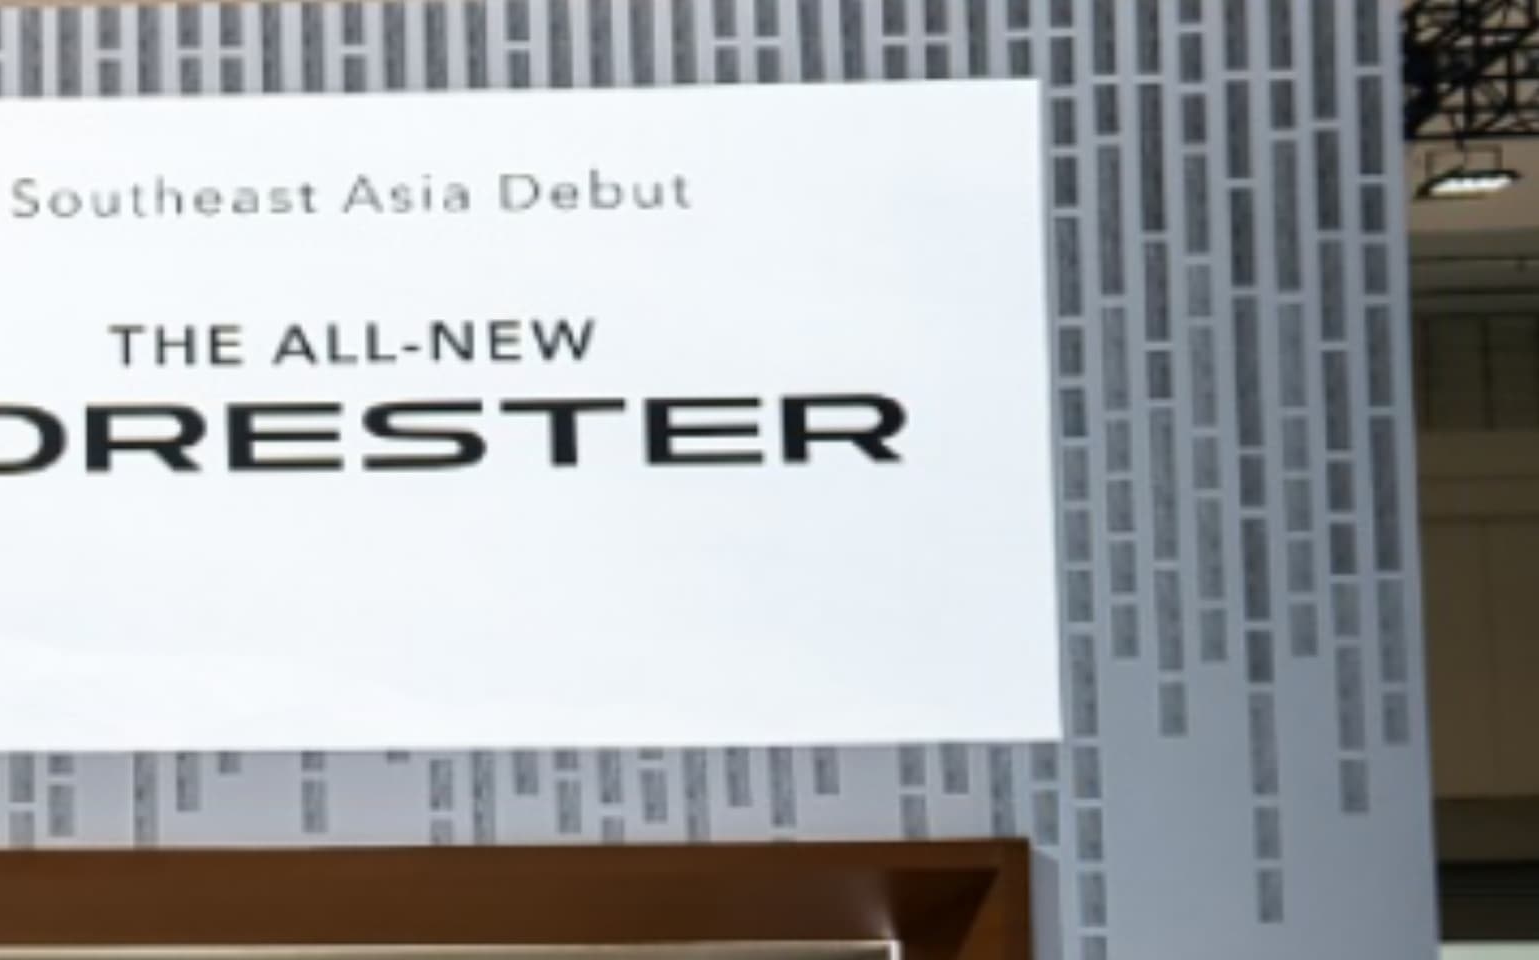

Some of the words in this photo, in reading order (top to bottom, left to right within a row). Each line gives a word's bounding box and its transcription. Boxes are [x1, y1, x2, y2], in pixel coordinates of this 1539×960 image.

[10, 176, 317, 219] Southeast
[342, 174, 471, 214] Asia
[499, 169, 691, 211] Debut
[109, 323, 244, 367] THE
[272, 319, 596, 365] ALL-NEW
